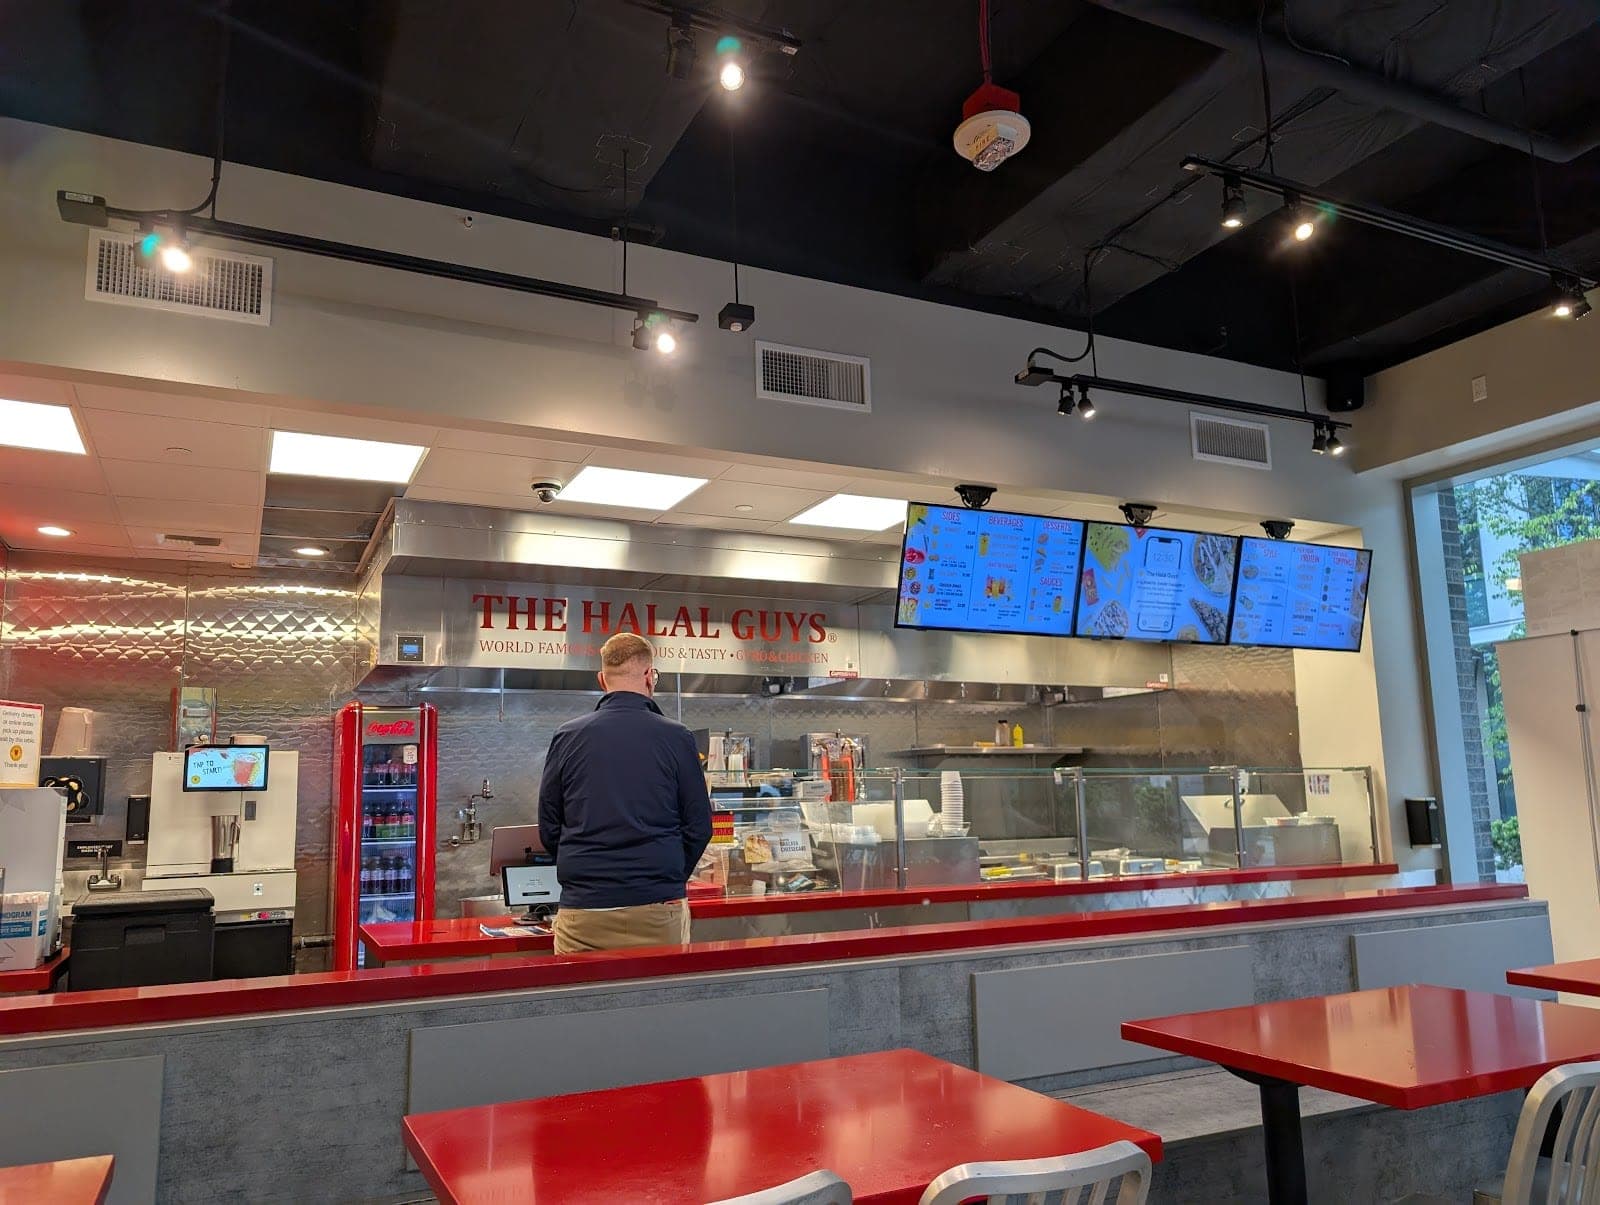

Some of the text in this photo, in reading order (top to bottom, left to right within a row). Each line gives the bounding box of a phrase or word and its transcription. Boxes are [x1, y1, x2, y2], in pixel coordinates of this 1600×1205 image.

[942, 511, 961, 521] SIDES
[988, 516, 1024, 527] BEVERAGES
[1043, 521, 1073, 531] DESSERTS
[1152, 552, 1175, 562] 12:30
[1040, 577, 1063, 587] SAUCES
[473, 594, 568, 632] THE
[581, 600, 720, 639] HALAL
[480, 640, 533, 654] WORLD
[538, 642, 594, 656] FAMOUS
[677, 648, 687, 659] &
[691, 648, 727, 660] TASTY
